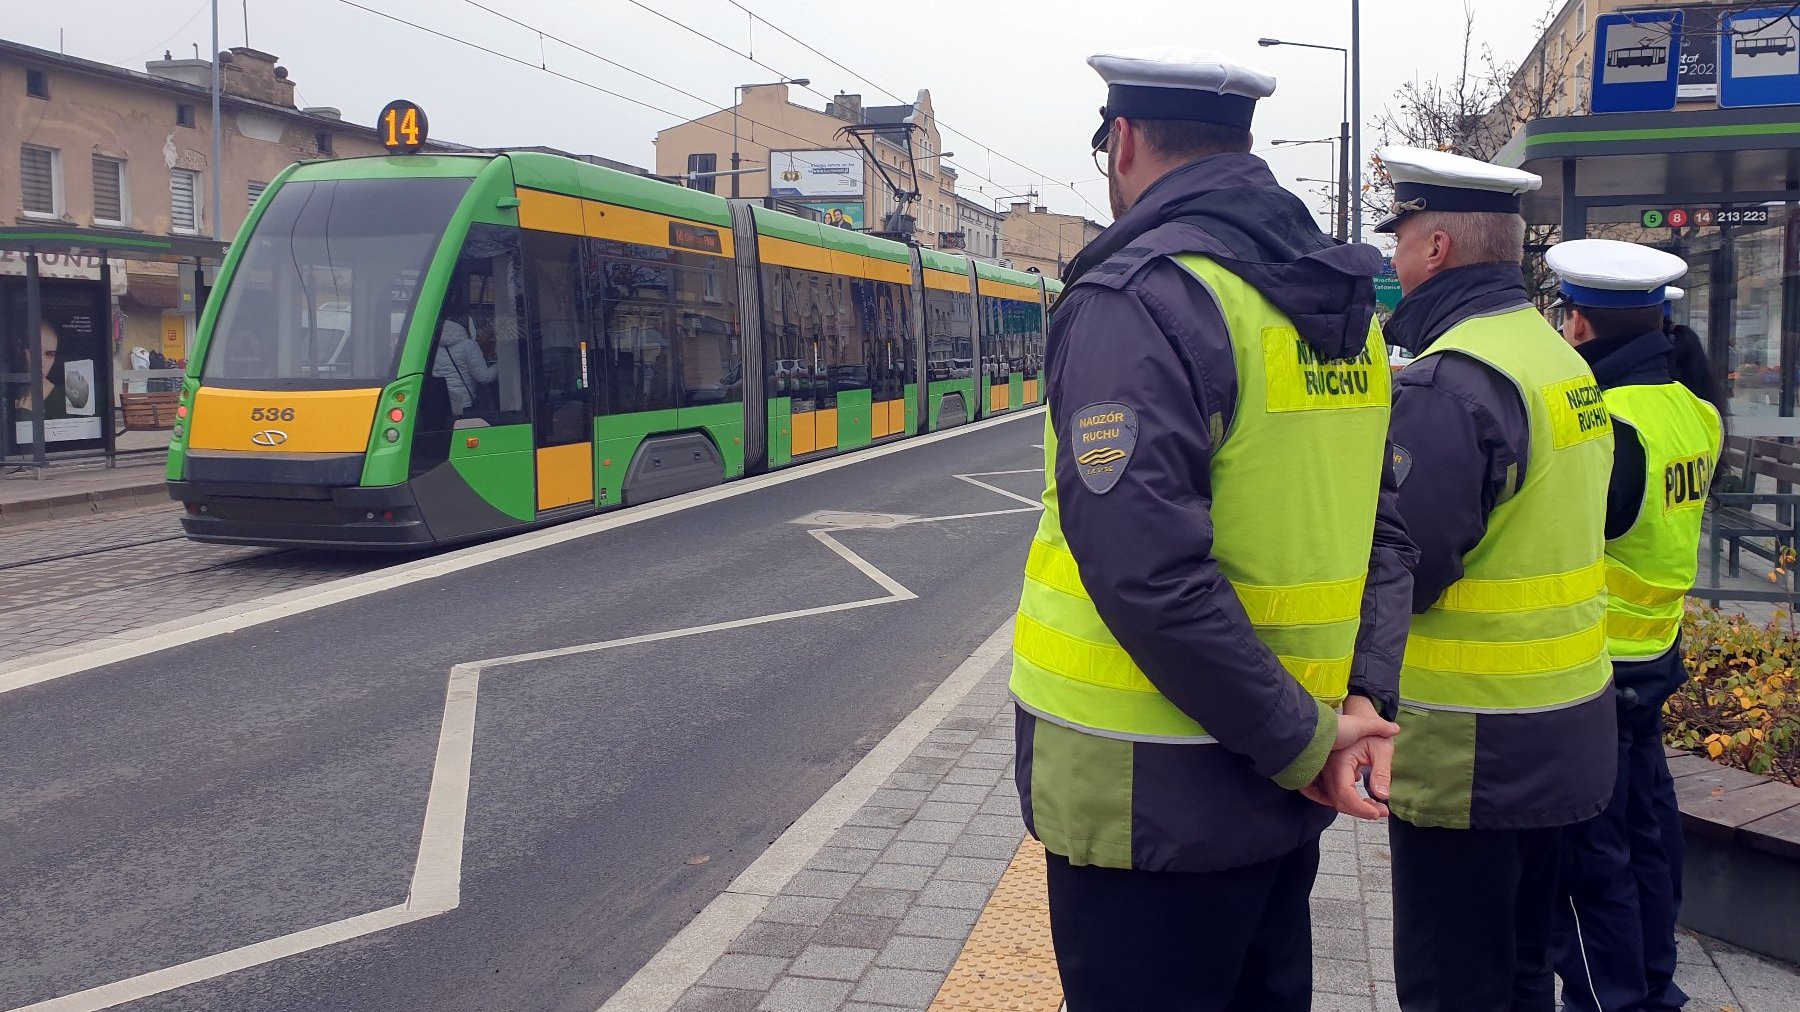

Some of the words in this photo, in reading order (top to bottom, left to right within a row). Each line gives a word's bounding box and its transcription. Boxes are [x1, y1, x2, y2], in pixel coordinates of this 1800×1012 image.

[1689, 63, 1716, 75] 202
[385, 108, 419, 146] 14
[1649, 213, 1657, 222] 5
[1673, 213, 1681, 223] 8
[1695, 213, 1711, 222] 14
[1717, 212, 1740, 222] 213
[1743, 211, 1767, 221] 223
[1304, 370, 1368, 396] RUCHU
[250, 407, 296, 422] 536
[1079, 411, 1125, 428] NADZÓR
[1578, 407, 1607, 432] RUCHU
[1083, 428, 1120, 442] RUCHU
